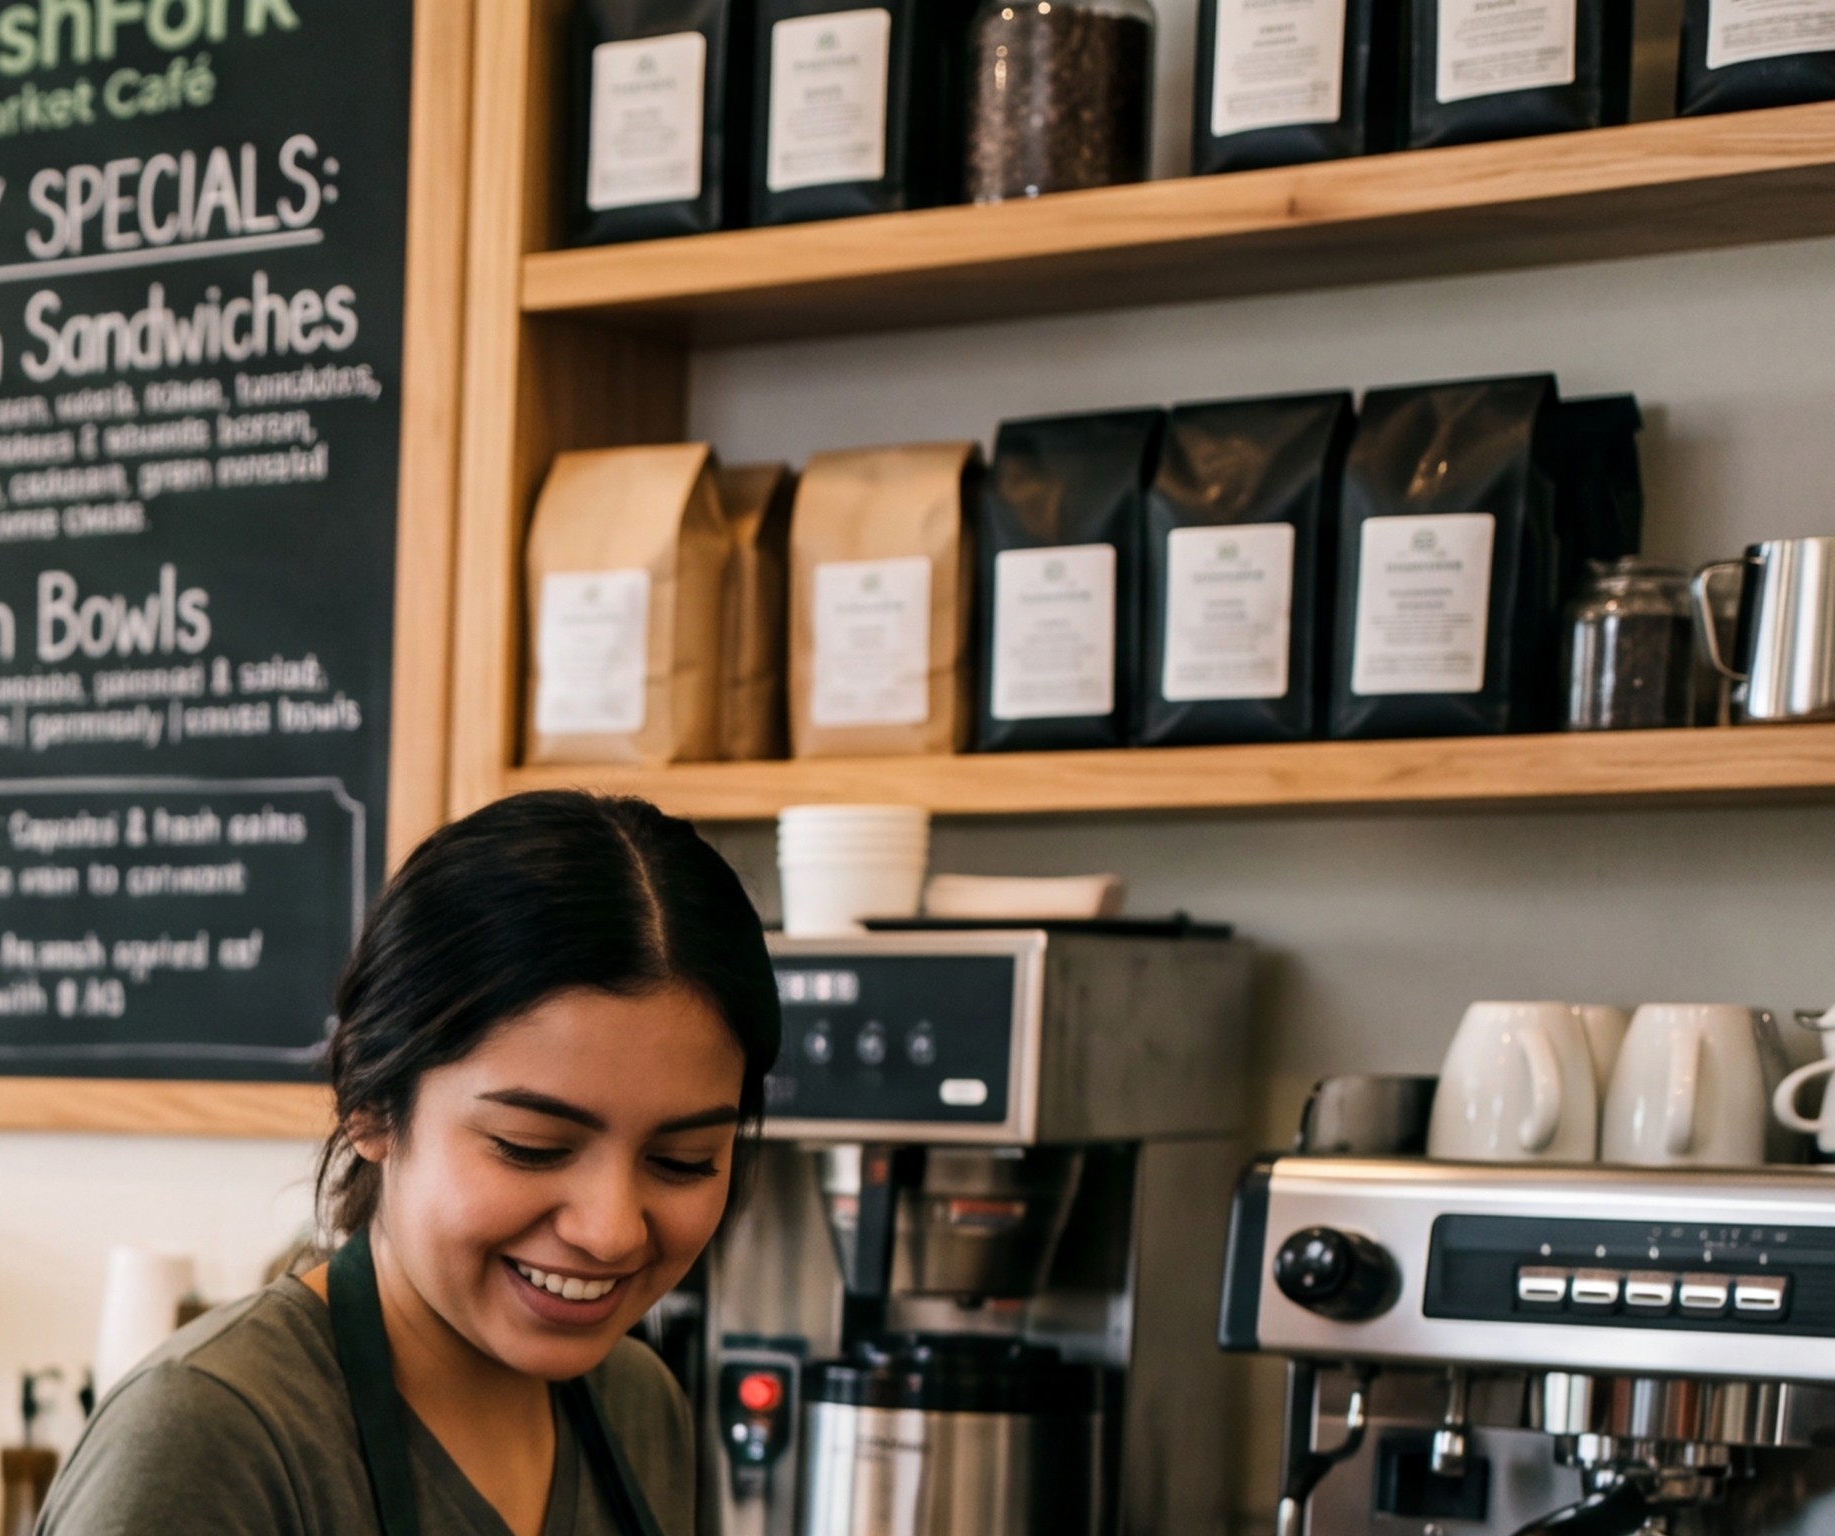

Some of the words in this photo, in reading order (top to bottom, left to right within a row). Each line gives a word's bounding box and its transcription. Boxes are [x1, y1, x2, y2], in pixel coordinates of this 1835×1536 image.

[104, 51, 215, 120] Café
[26, 134, 341, 260] SPECIALS:
[20, 270, 359, 382] Sandwiches
[35, 563, 213, 663] Bowls
